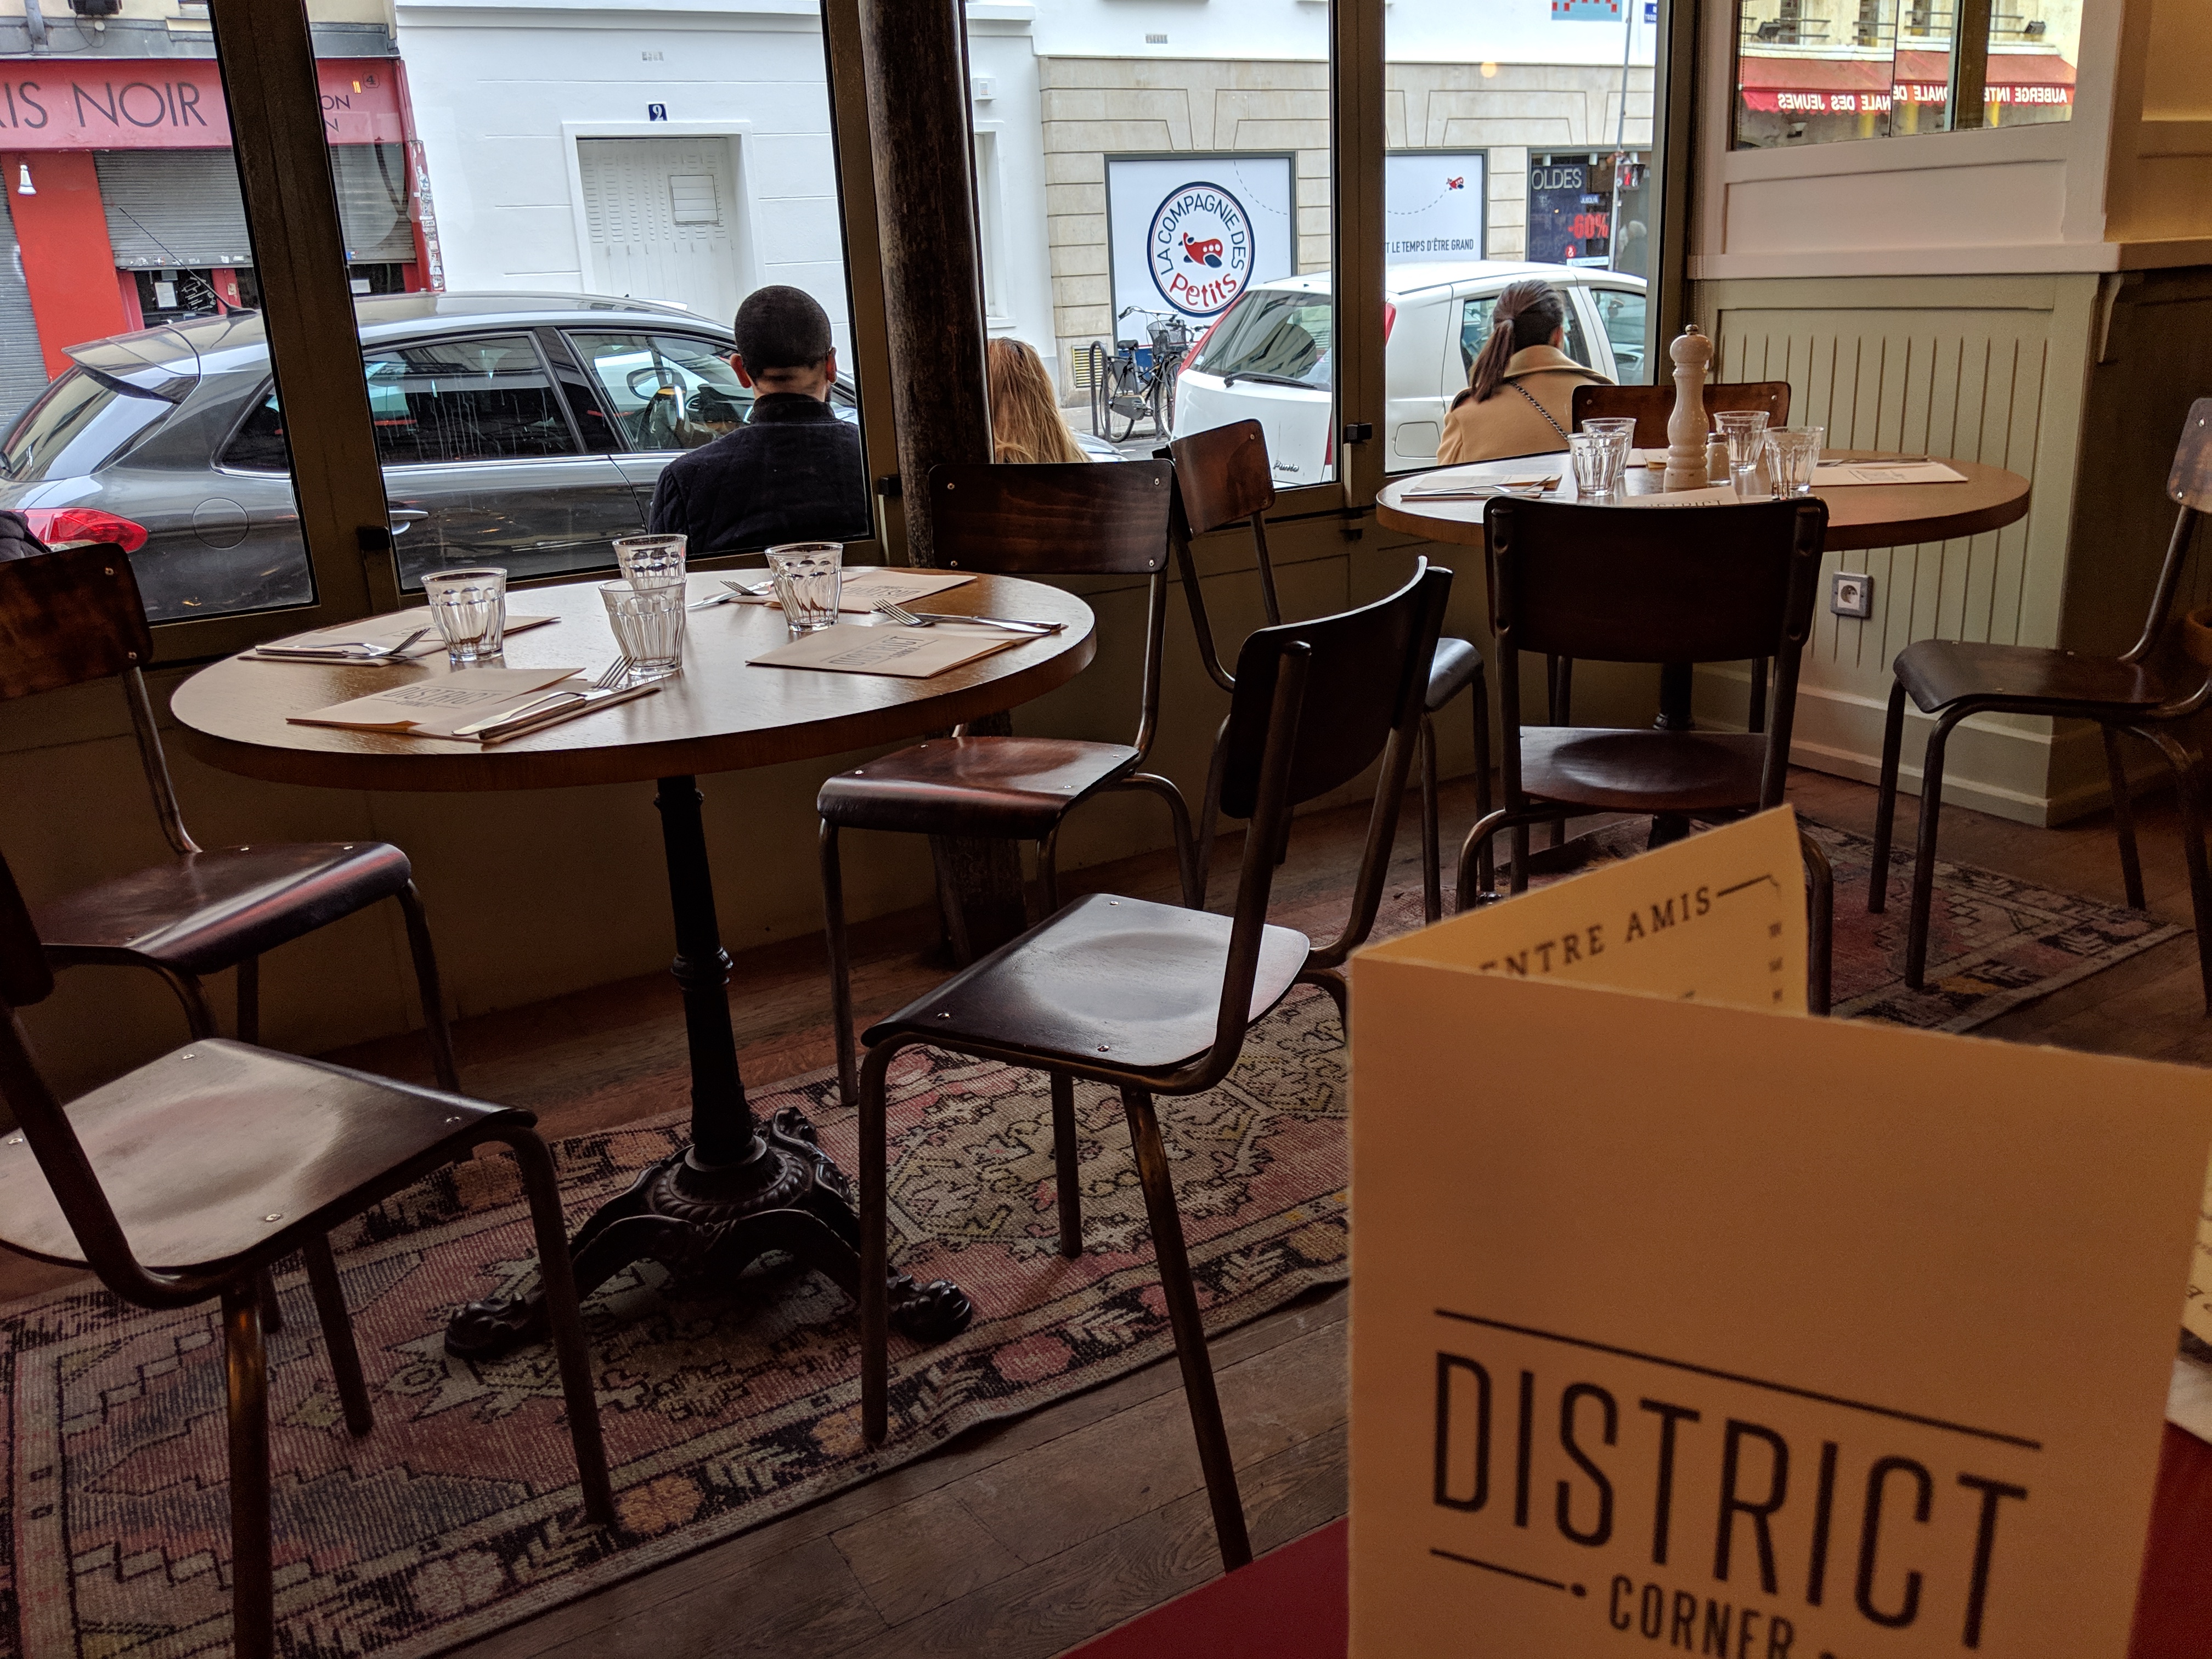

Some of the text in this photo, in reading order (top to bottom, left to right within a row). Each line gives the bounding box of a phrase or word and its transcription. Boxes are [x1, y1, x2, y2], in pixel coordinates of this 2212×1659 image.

[366, 75, 376, 84] 4
[72, 82, 208, 127] NOIR
[1532, 168, 1582, 190] OLDES
[1156, 193, 1246, 275] LA COMPAGNIE DES
[1568, 212, 1609, 240] -60%
[1392, 242, 1400, 253] LE
[1402, 241, 1425, 253] TEMPS
[1427, 238, 1449, 251] D'ÊTRE
[1452, 239, 1474, 250] GRAND
[1169, 273, 1237, 307] Petits
[1273, 460, 1299, 472] Punto
[382, 687, 502, 705] DISTRICT
[1625, 885, 1711, 943] AMIS
[1434, 1351, 2028, 1650] DISTRICT
[1609, 1573, 1796, 1659] CORNER
